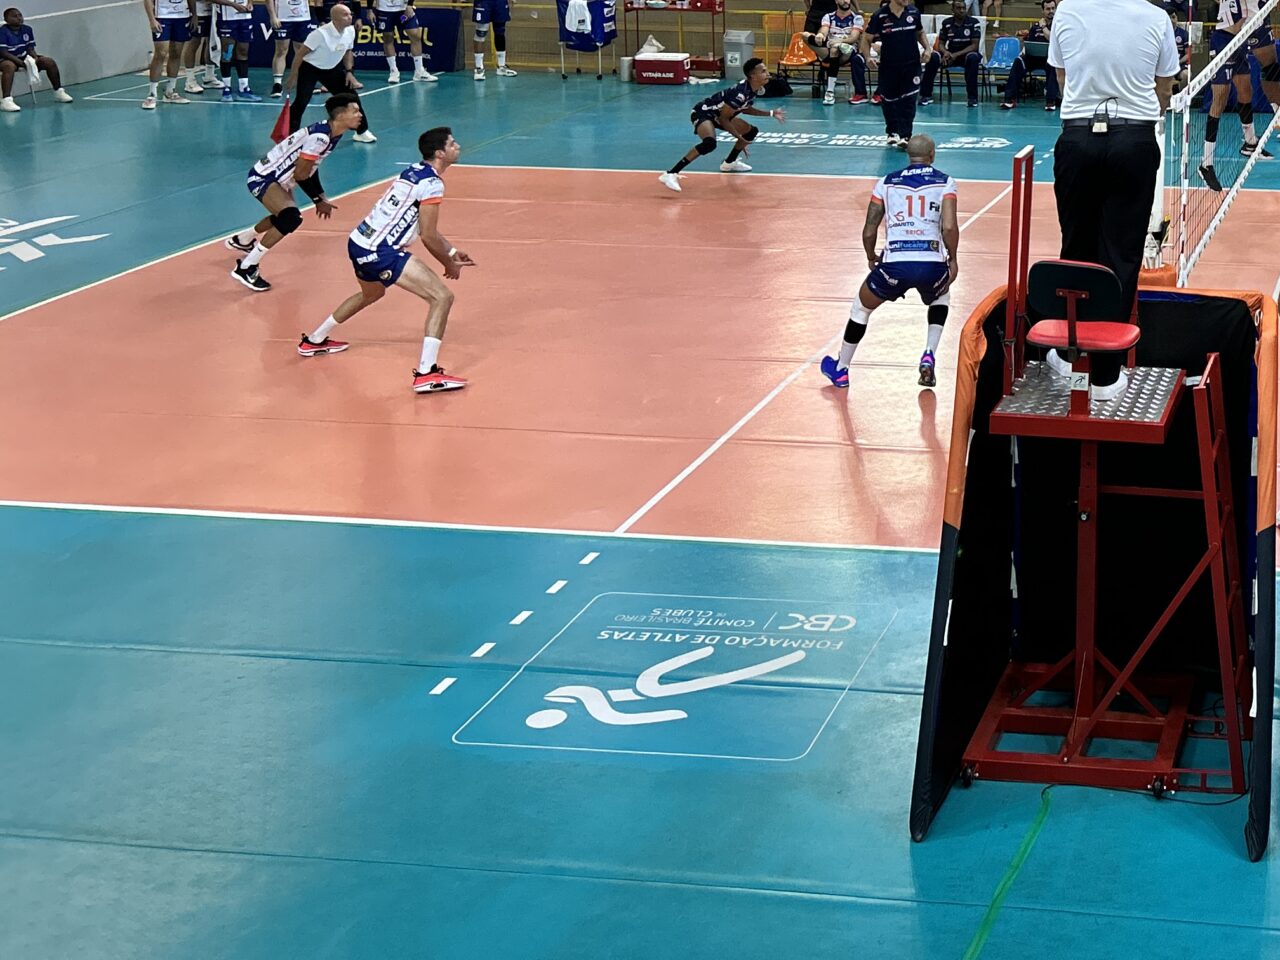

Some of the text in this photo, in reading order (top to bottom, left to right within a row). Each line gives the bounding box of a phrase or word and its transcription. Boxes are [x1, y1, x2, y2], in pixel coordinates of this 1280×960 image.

[905, 195, 926, 218] 11
[888, 241, 929, 250] unifucamp
[650, 607, 713, 619] CLUBES
[614, 614, 756, 627] COMITÊ BRASILEIRO
[597, 630, 844, 649] FORMAÇÃO DE ATLETAS
